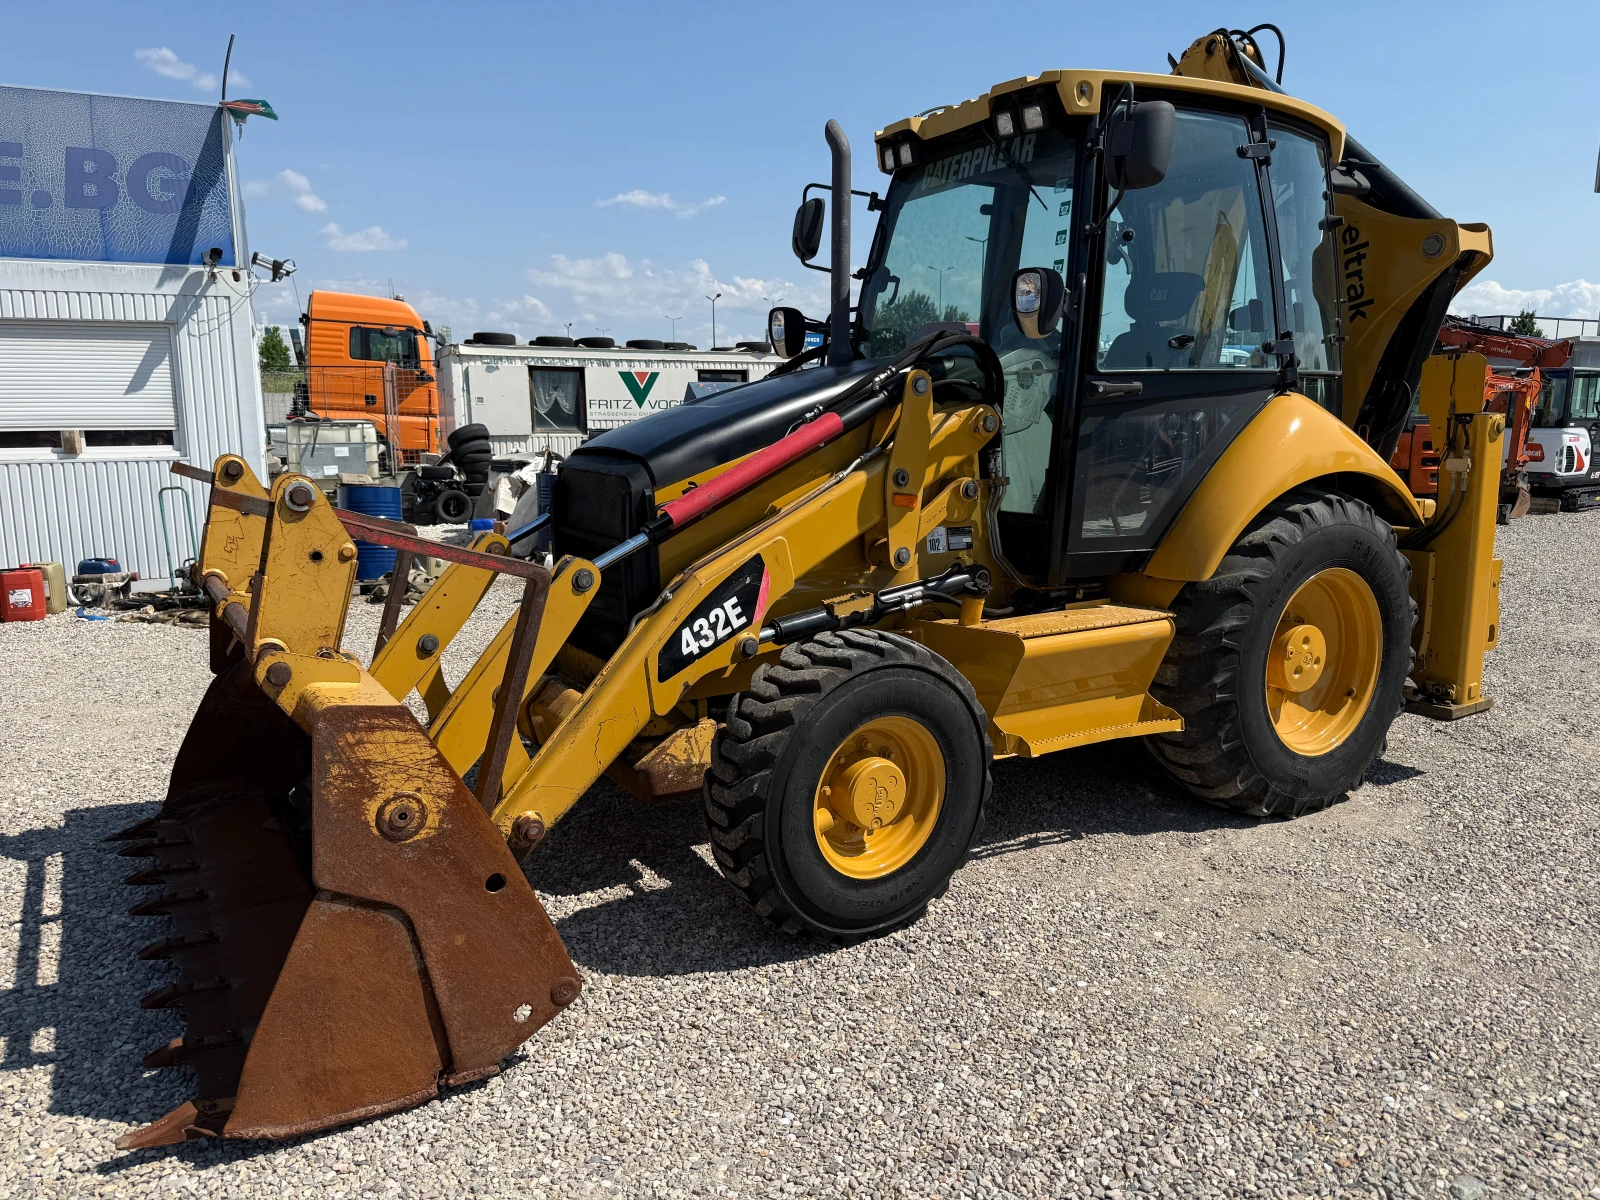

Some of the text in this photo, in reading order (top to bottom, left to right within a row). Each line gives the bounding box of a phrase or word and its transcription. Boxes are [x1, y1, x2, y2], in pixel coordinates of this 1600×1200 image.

[922, 134, 1037, 191] CATERPILLAR
[1342, 223, 1374, 325] eltrak
[1149, 289, 1169, 301] CAT
[1490, 346, 1512, 355] HITACHI
[589, 399, 633, 410] FRITZ
[1524, 449, 1542, 457] obcat
[928, 538, 941, 551] 102
[1359, 543, 1406, 626] ALLIANCE
[681, 595, 748, 657] 432E
[844, 897, 885, 911] STEER
